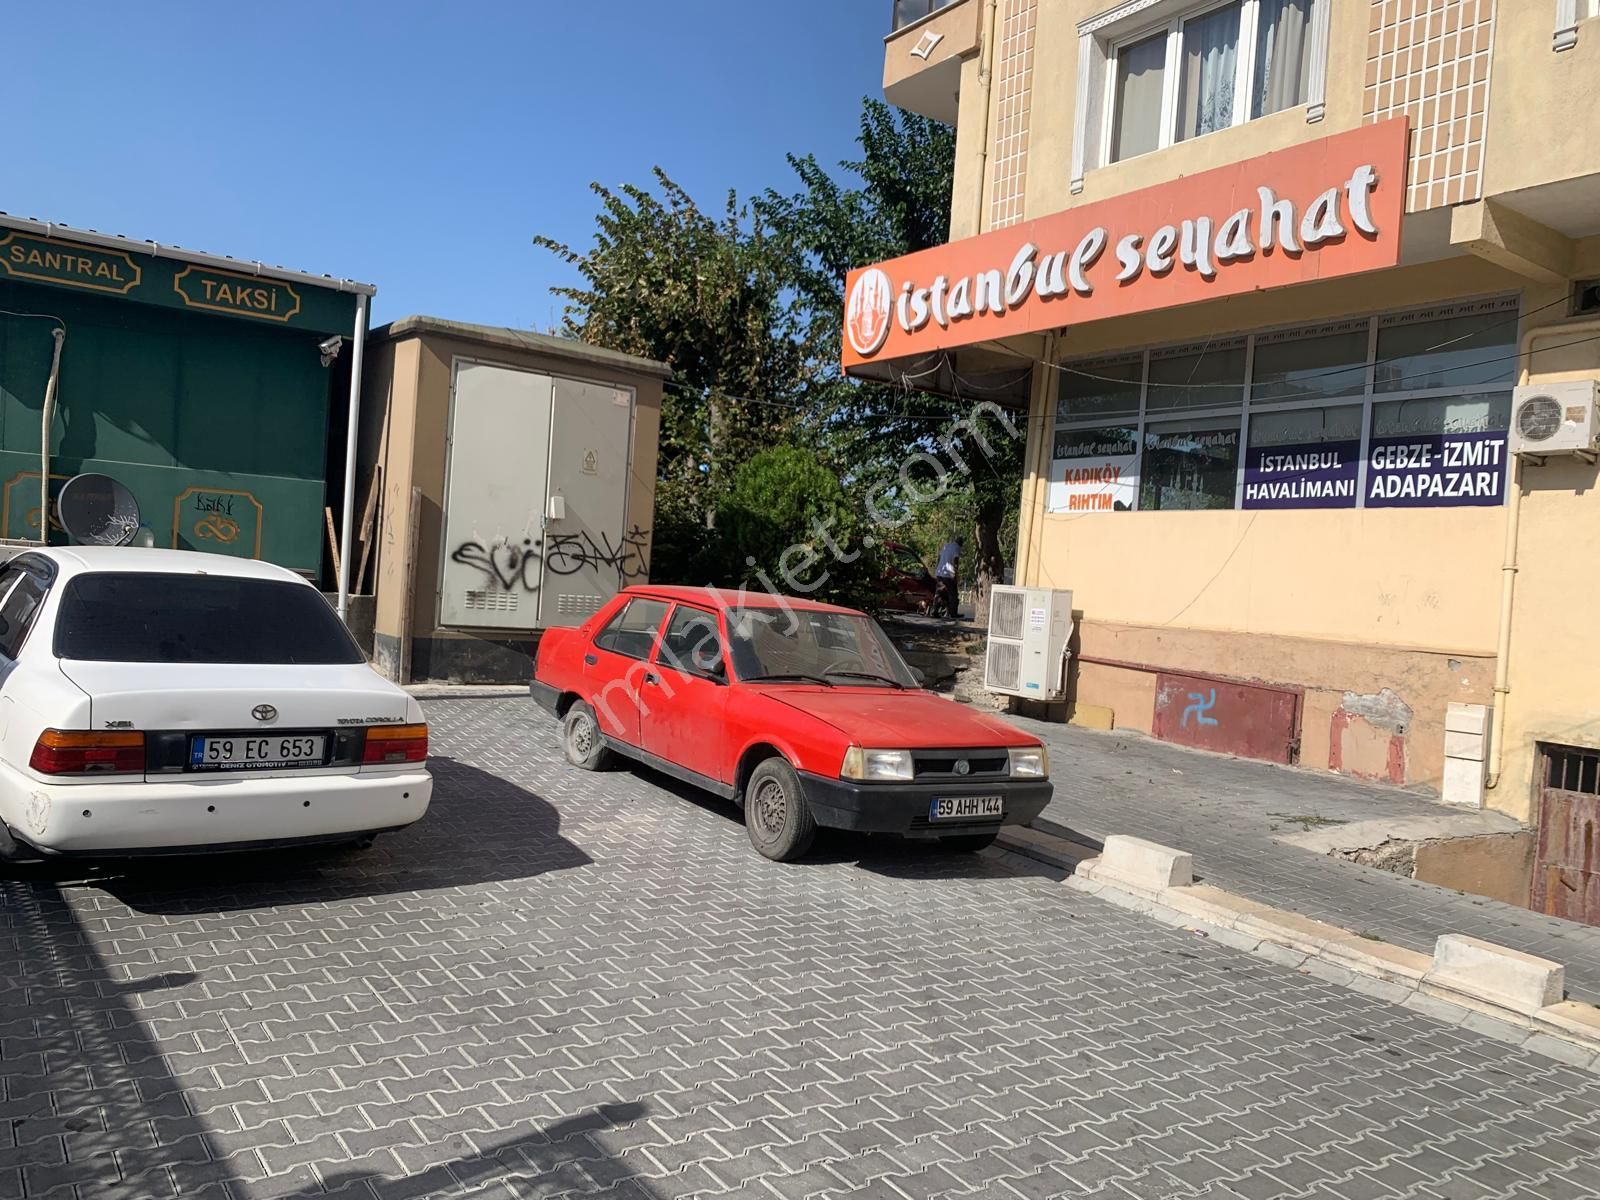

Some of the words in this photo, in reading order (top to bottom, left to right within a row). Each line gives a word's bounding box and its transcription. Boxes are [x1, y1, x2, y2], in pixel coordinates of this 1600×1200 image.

[897, 227, 1108, 332] istanbul
[1115, 164, 1378, 282] seyahat
[10, 245, 125, 281] SANTRAL
[201, 279, 276, 312] TAKSİ
[1260, 452, 1342, 473] İSTANBUL
[1064, 463, 1121, 485] KADIKÖY
[1369, 471, 1499, 498] ADAPAZARI
[1246, 478, 1355, 500] HAVALİMANI
[1068, 493, 1113, 511] RIHTIM
[208, 740, 234, 760] 59
[245, 740, 269, 759] EC
[280, 739, 315, 758] 653
[938, 800, 954, 815] 59
[956, 799, 979, 815] AHH
[981, 798, 1000, 814] 144
